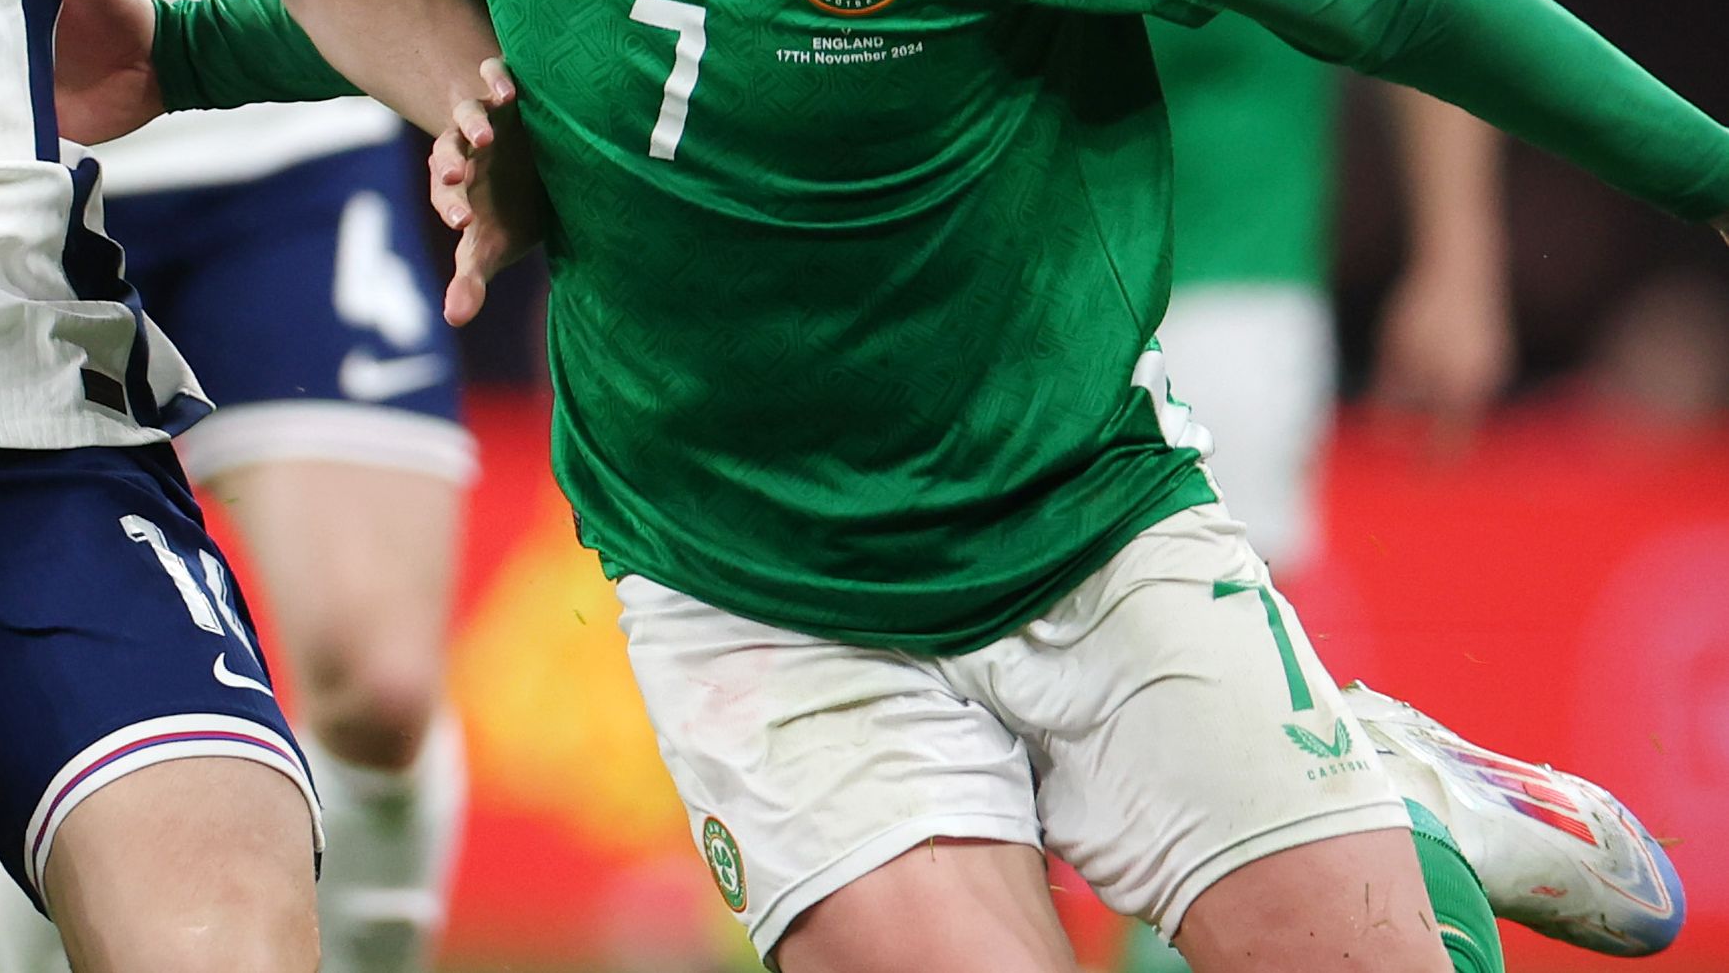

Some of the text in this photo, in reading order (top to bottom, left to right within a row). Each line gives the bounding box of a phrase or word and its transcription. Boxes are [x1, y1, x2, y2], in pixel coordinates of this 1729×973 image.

[776, 41, 923, 64] 17TH November 2024
[812, 36, 884, 50] ENGLAND
[1213, 579, 1314, 712] 7
